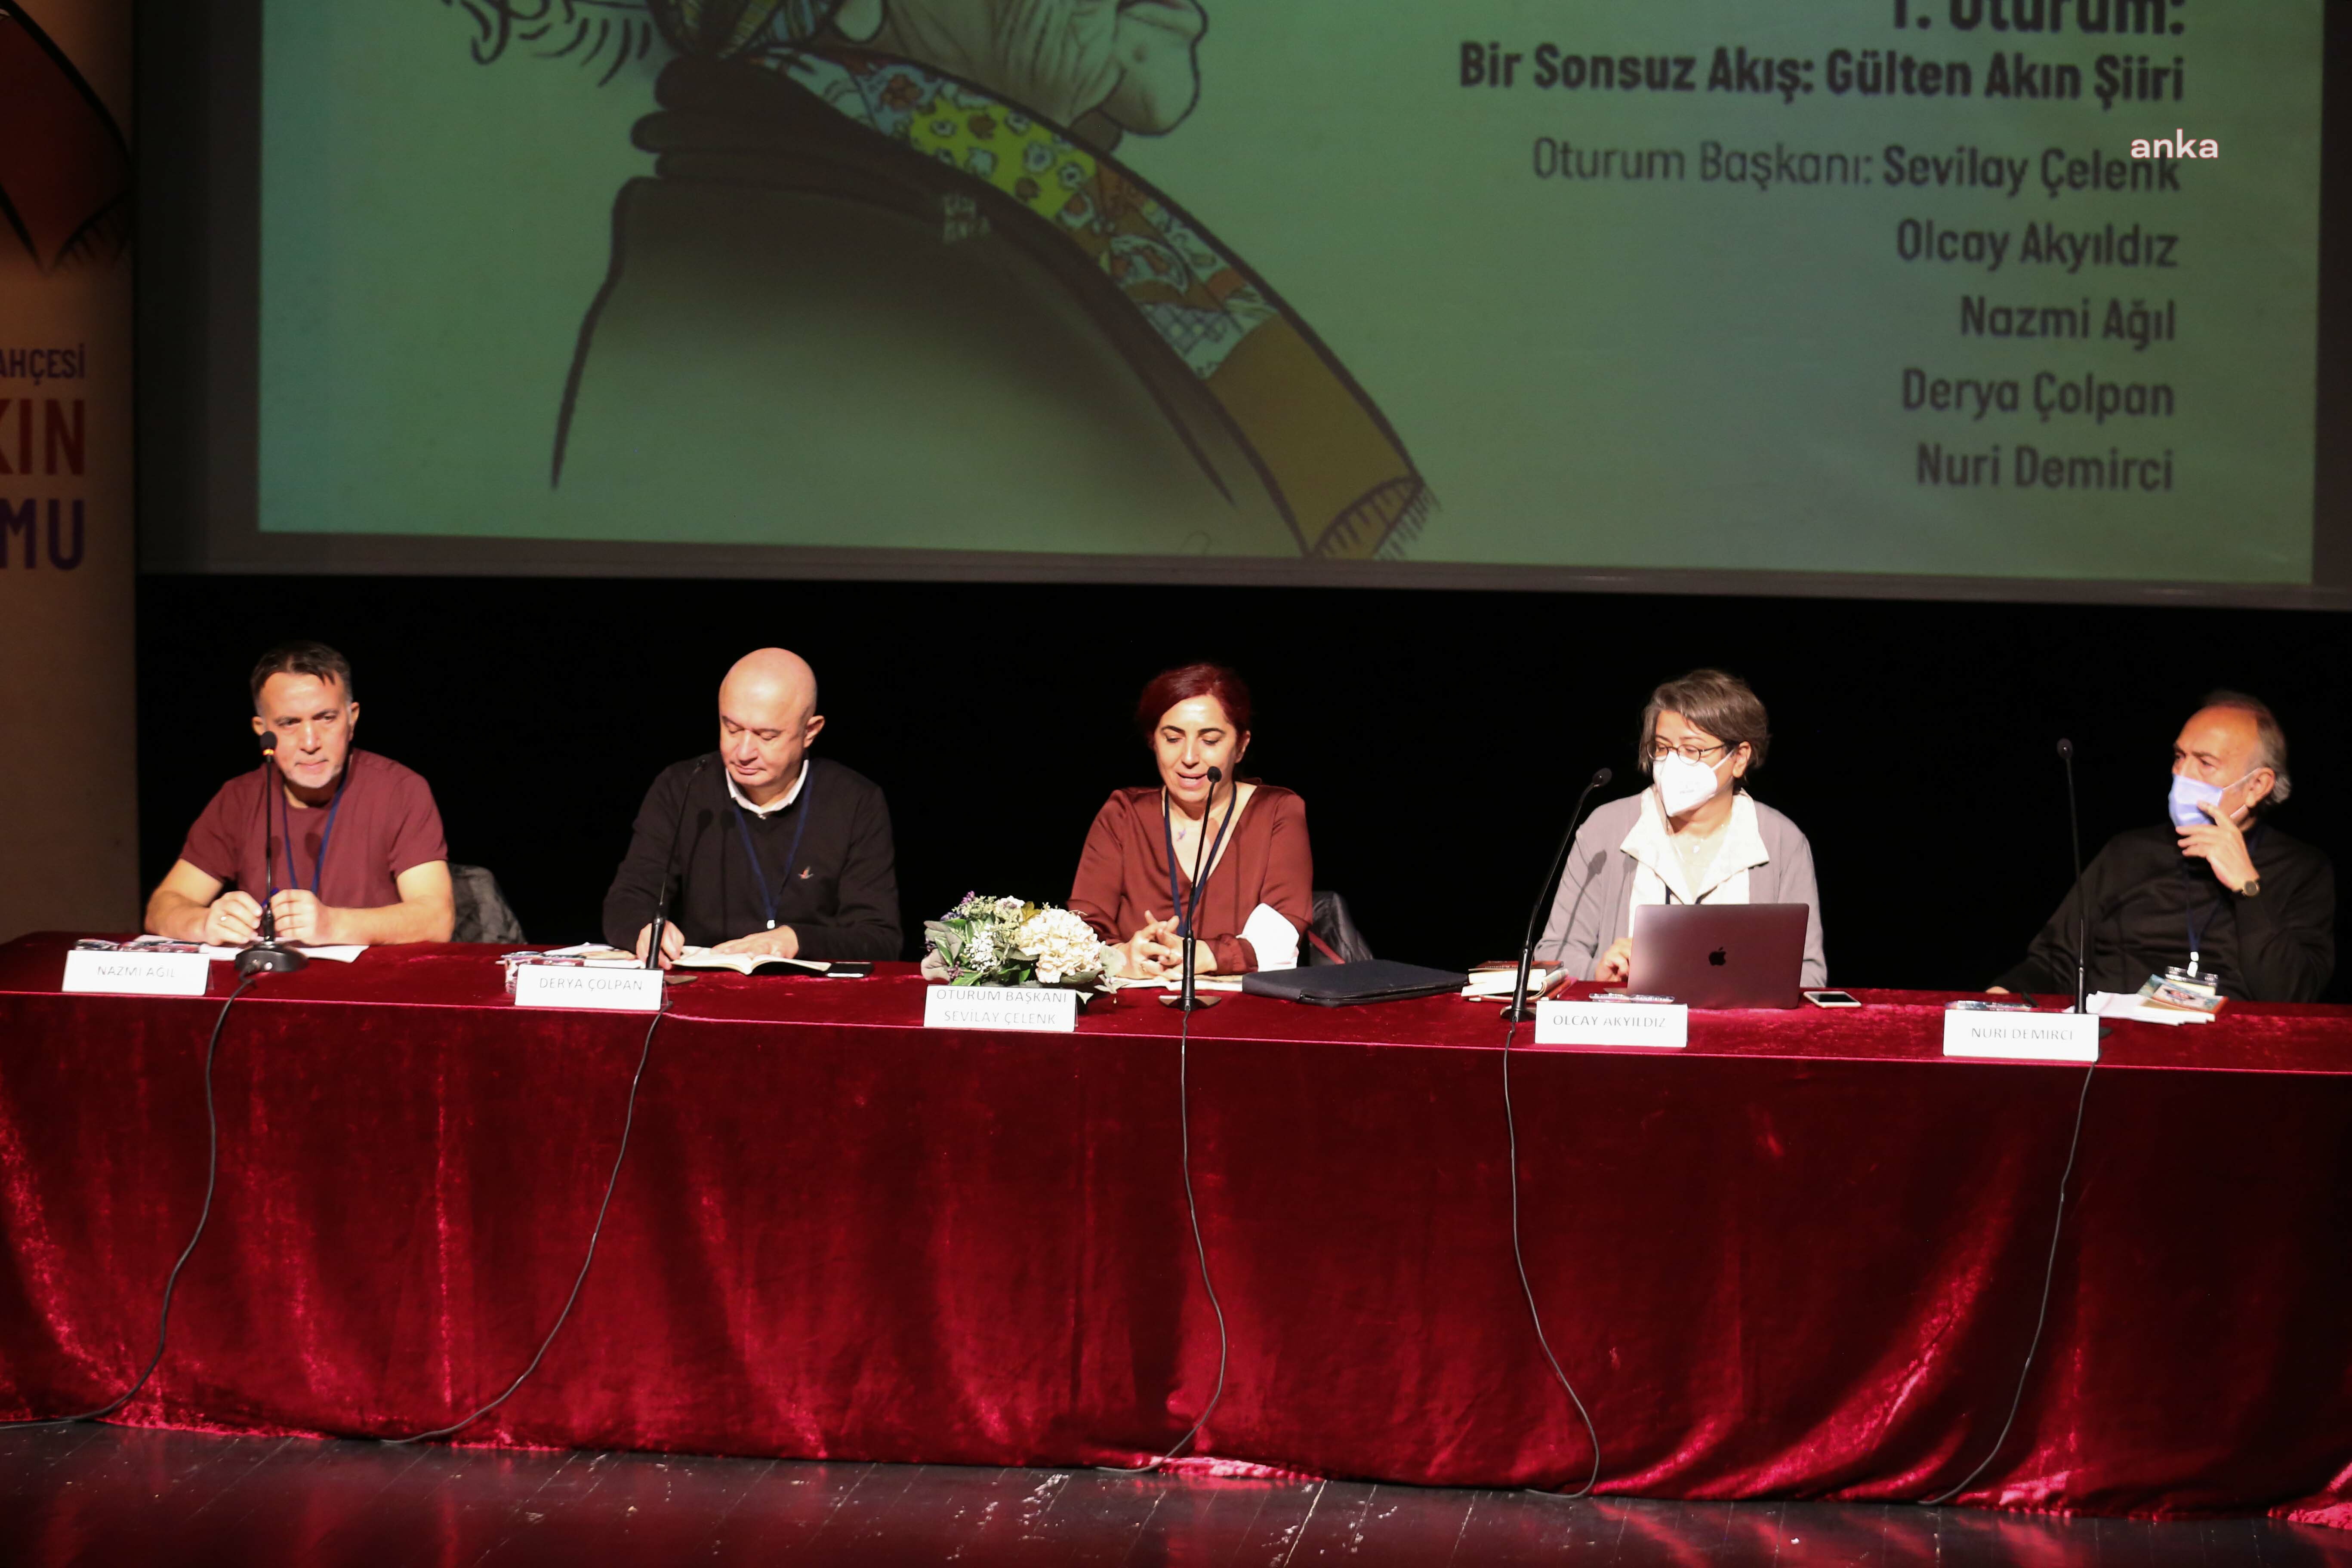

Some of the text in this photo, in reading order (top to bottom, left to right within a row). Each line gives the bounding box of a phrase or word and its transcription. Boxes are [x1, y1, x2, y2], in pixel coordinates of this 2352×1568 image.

[1461, 42, 2183, 110] Bir Sonsuz Akış: Gülten Akın Şiiri
[1534, 137, 2180, 198] Oturum Başkanı: Sevilay Çelenk
[1897, 218, 2179, 274] Olcay Akyıldız
[1961, 296, 2175, 351] Nazmi Ağıl
[1903, 368, 2174, 425] Derya Çolpan
[1917, 443, 2173, 491] Nuri Demirci
[540, 978, 642, 992] DERYA ÇOLPAN
[937, 989, 1066, 1004] OTURUM BAŞKANI
[945, 1009, 1055, 1025] SEVİLAY ÇELENK
[1554, 1016, 1665, 1027] OLCAY AKYILDIZ
